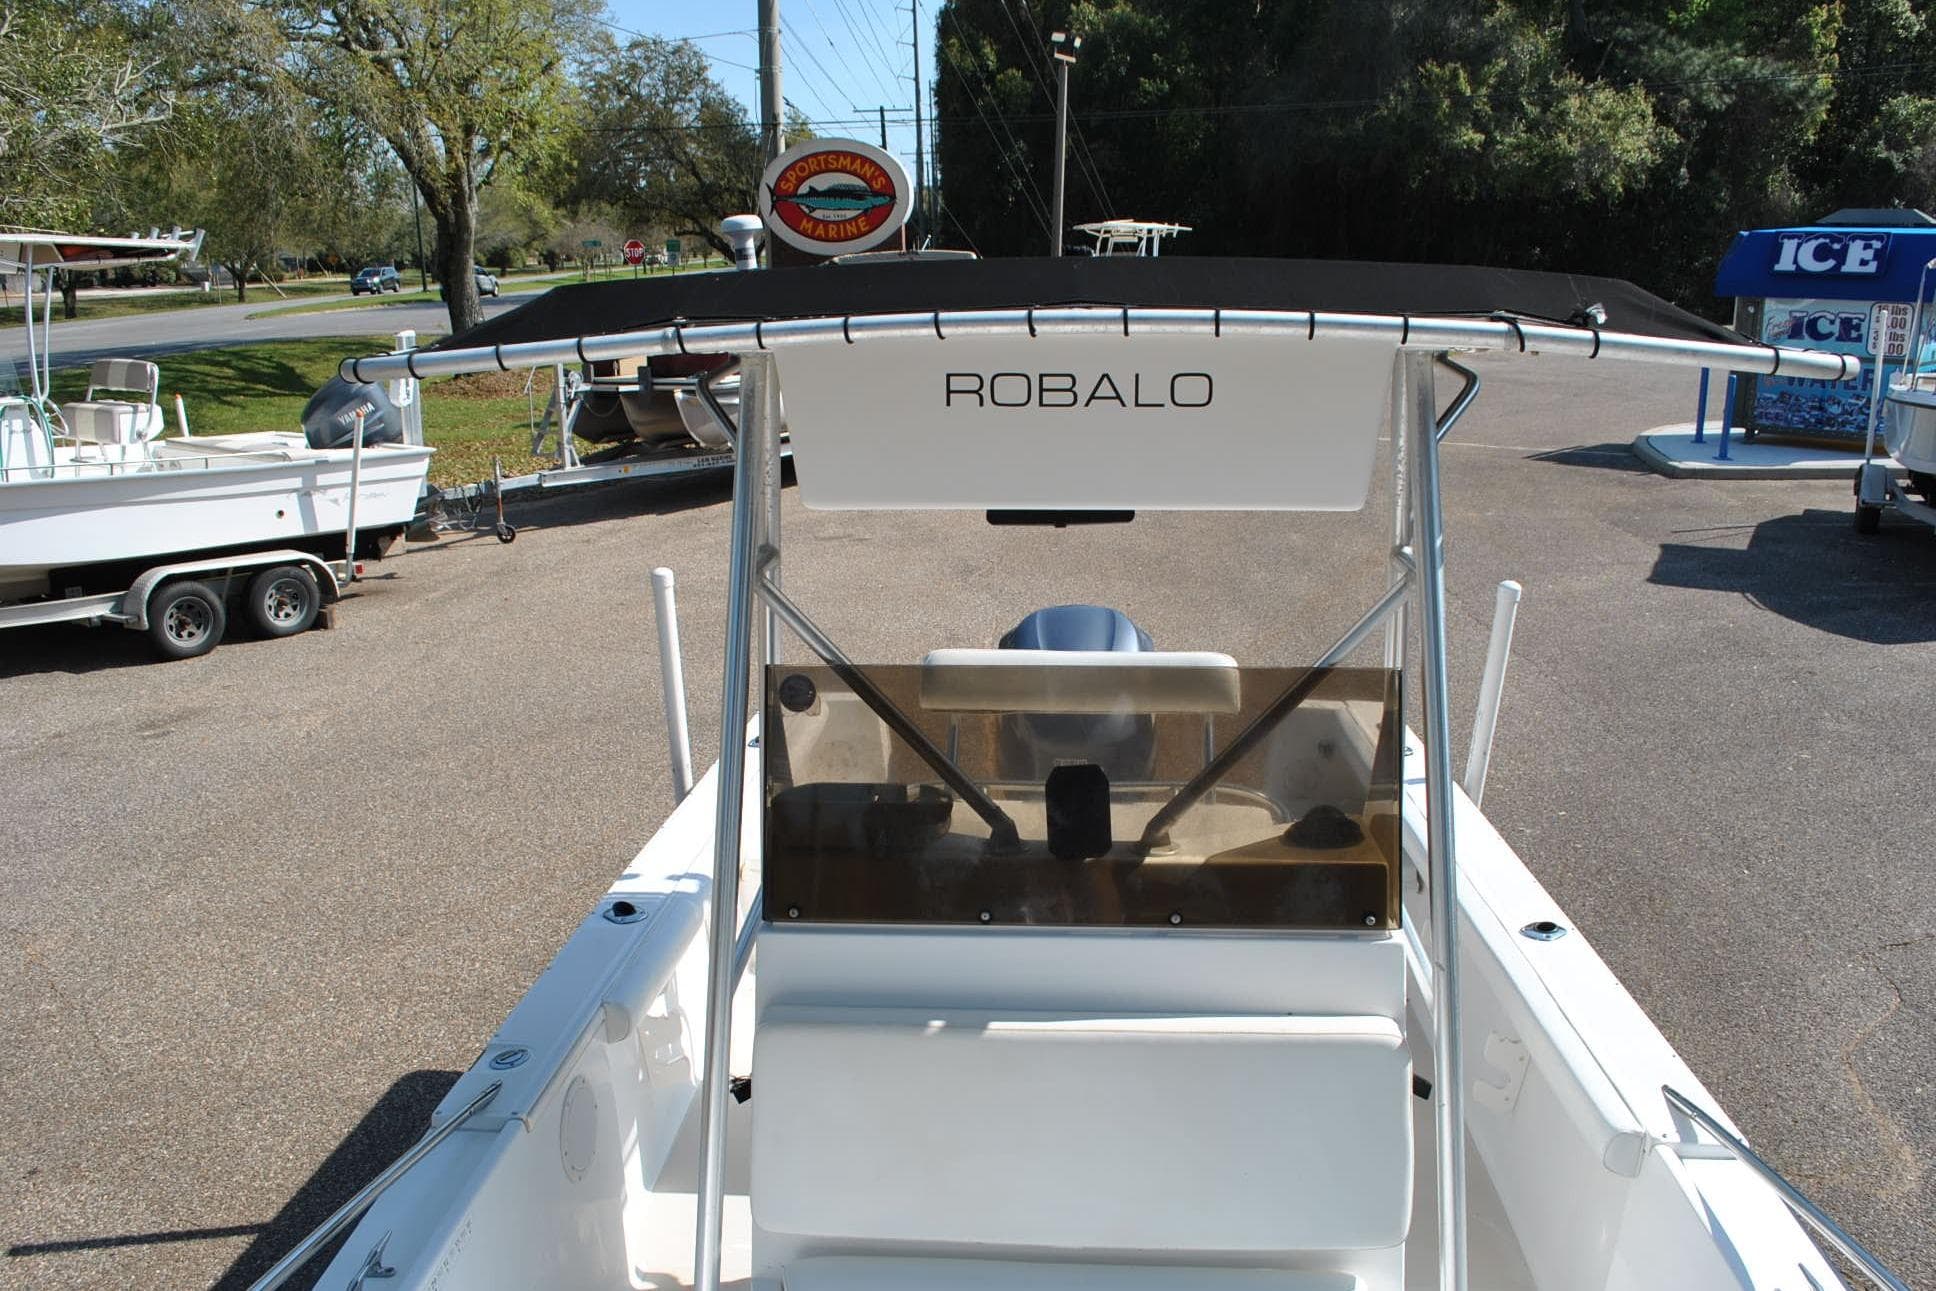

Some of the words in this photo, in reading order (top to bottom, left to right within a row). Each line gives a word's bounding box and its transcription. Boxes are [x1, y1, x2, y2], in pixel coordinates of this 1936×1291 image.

[781, 154, 886, 192] SPORTSMAN'S
[800, 216, 870, 239] MARINE
[625, 247, 644, 258] STOP
[1773, 236, 1883, 273] ICE
[1788, 310, 1867, 342] ICE
[945, 372, 1213, 407] ROBALO
[338, 402, 375, 425] YAMHA
